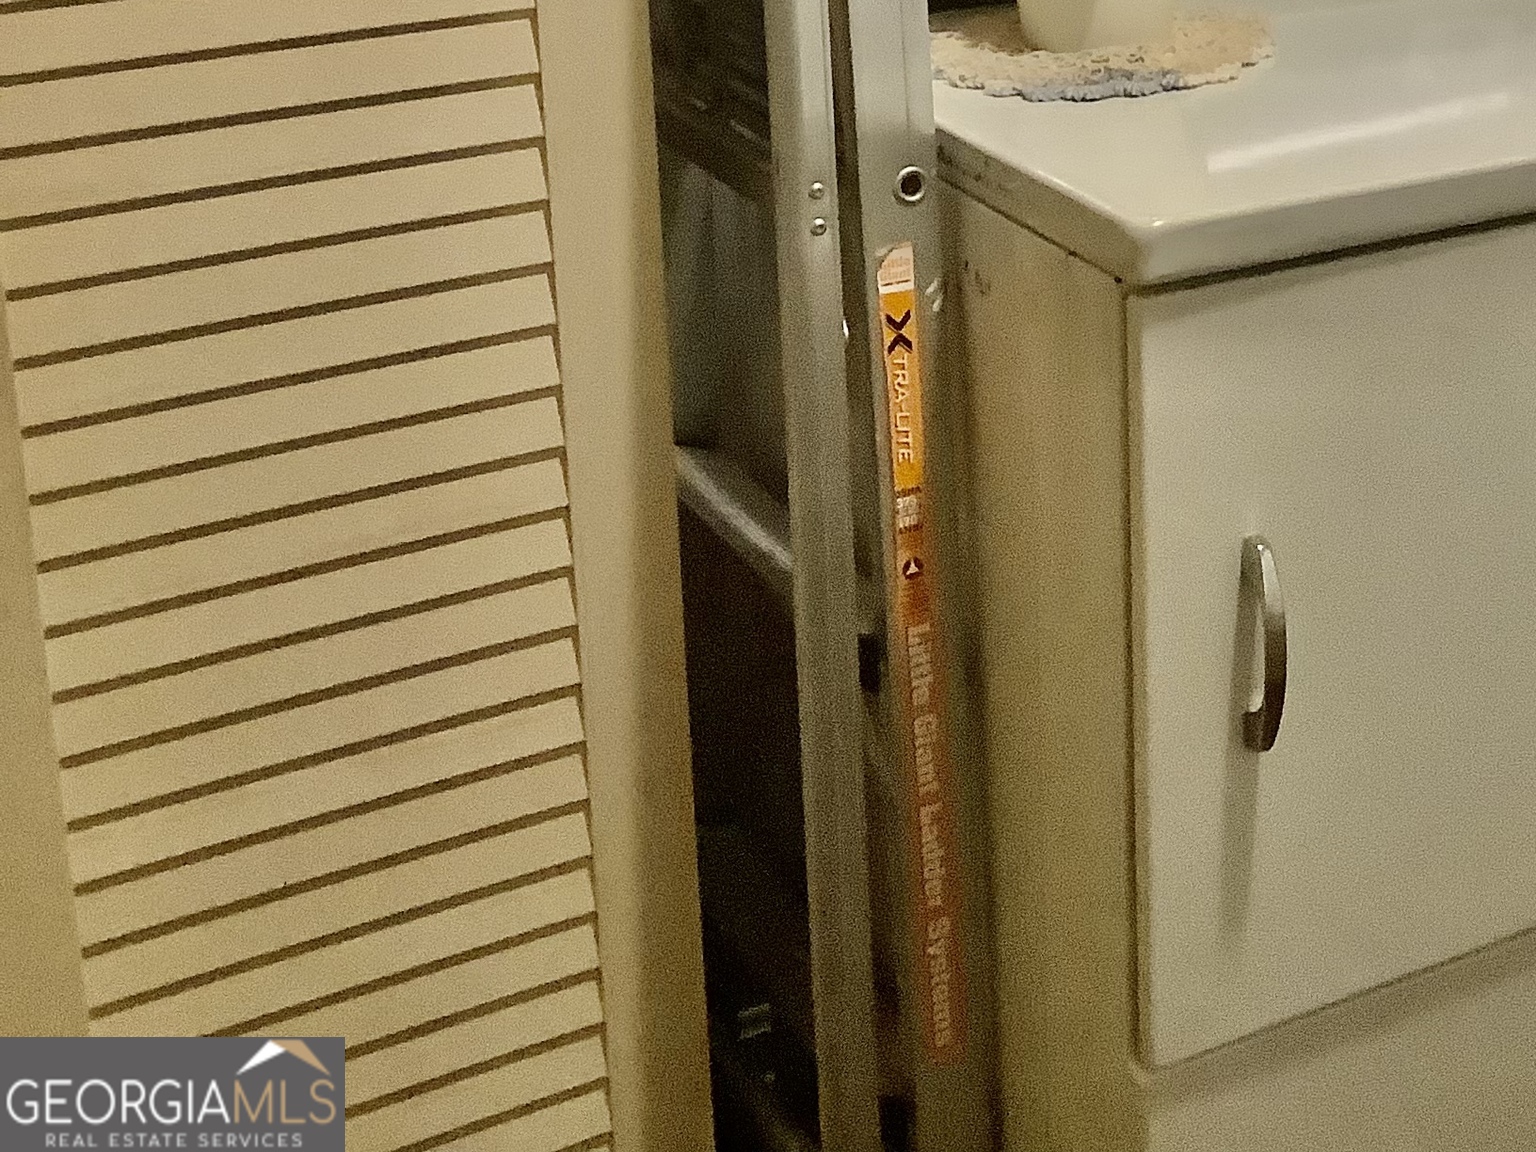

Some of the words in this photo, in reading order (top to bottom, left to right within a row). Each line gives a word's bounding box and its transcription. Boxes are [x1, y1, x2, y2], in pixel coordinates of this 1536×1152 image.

[908, 623, 934, 706] Little
[914, 714, 940, 794] Giant
[920, 802, 946, 906] Ladder
[927, 916, 951, 1047] Systems
